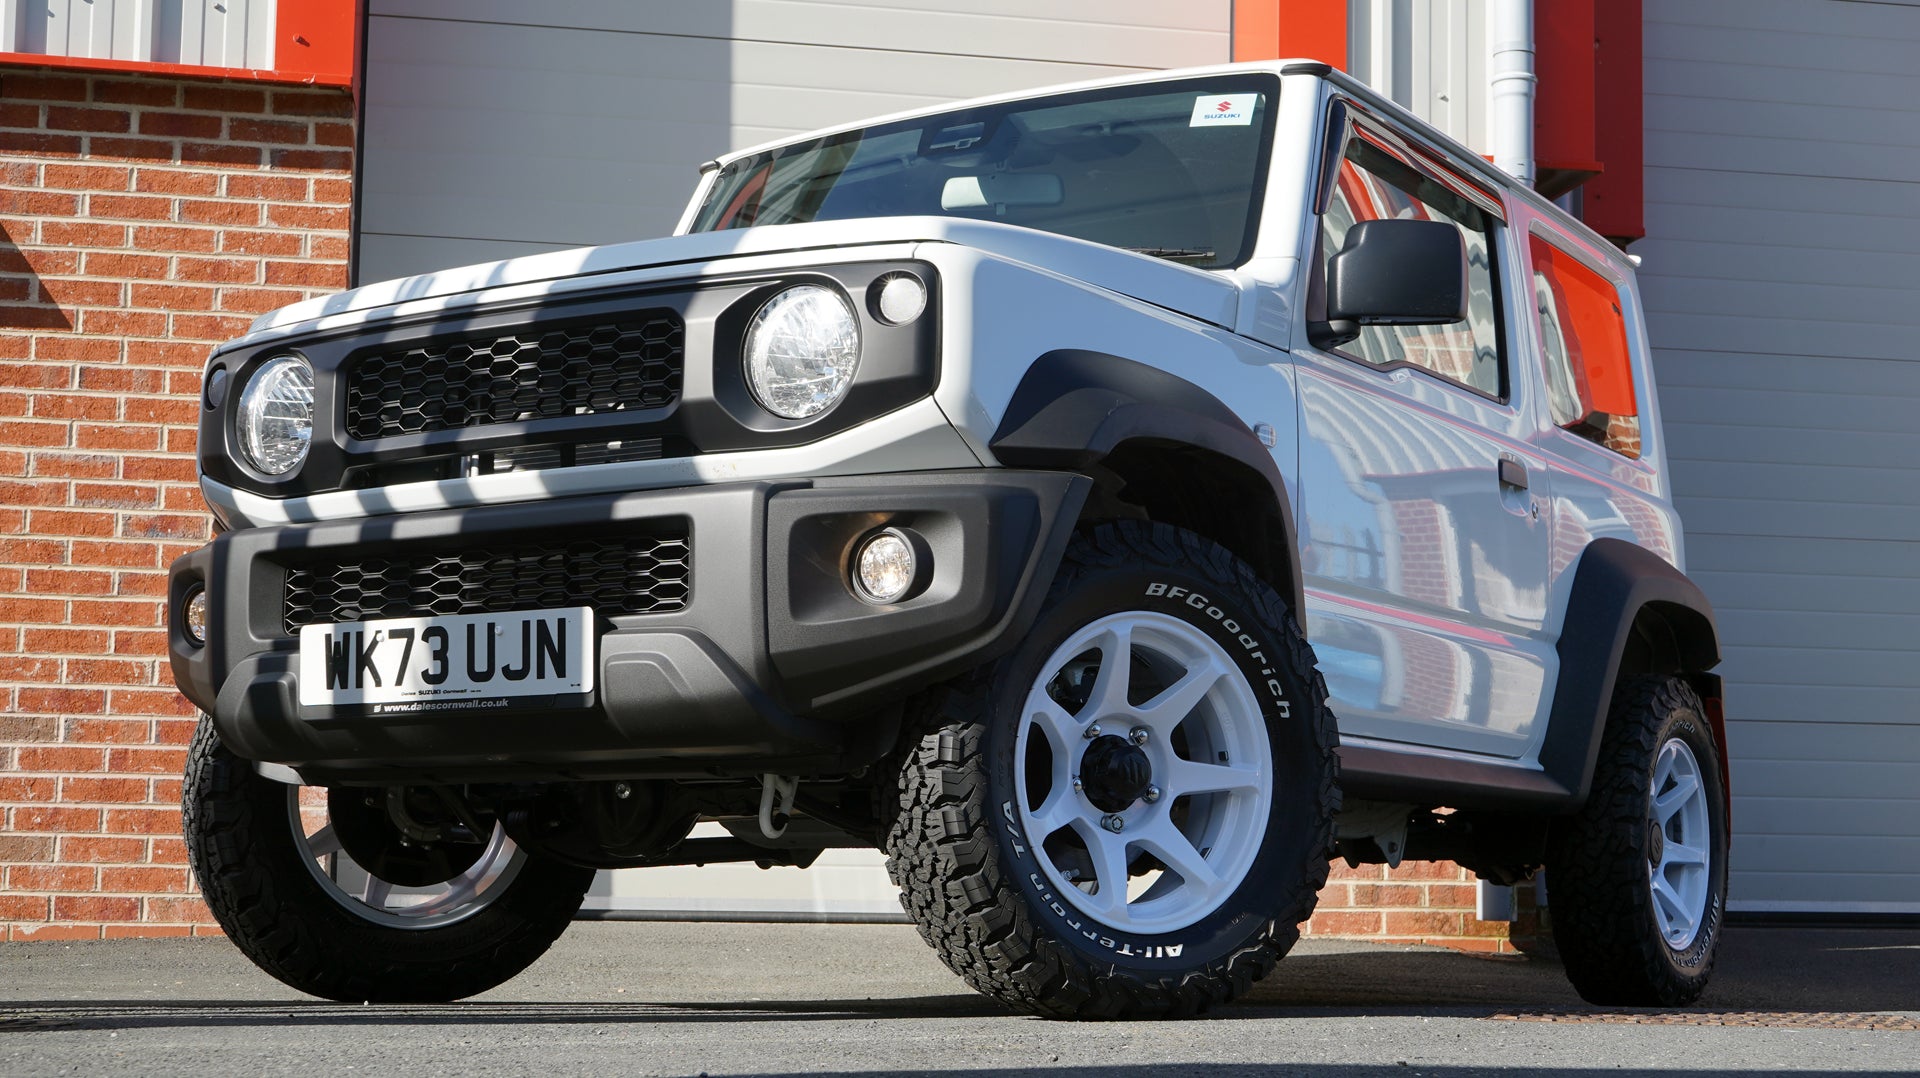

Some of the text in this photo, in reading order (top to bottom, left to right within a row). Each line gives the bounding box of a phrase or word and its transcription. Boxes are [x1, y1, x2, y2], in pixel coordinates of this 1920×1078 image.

[324, 617, 566, 690] WK73 UJN
[1145, 582, 1291, 719] BFGoodrich
[384, 698, 509, 713] www.dalescornwall.co.uk
[418, 688, 441, 696] SUZUKI
[1002, 800, 1184, 958] All-Terrain T/A
